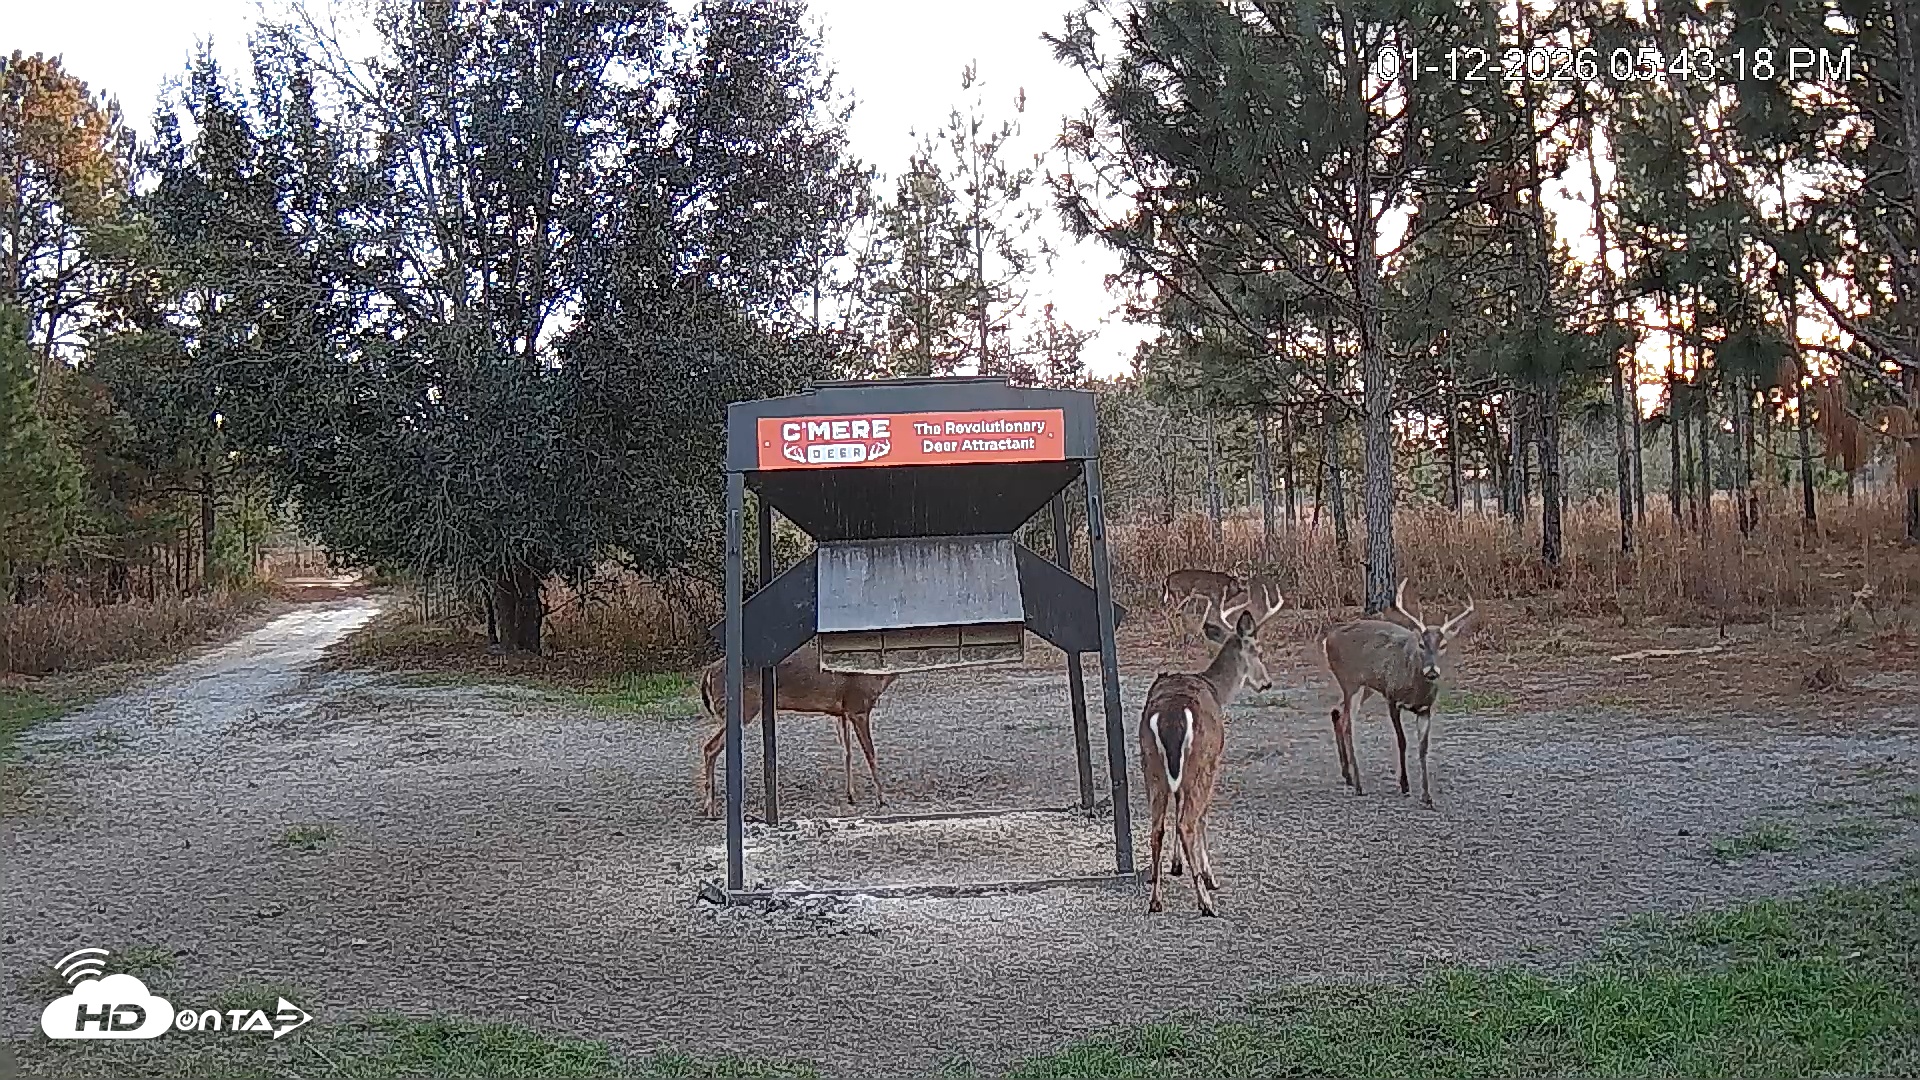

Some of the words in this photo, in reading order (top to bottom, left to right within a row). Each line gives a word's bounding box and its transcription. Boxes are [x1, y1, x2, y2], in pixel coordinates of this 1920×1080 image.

[914, 422, 940, 435] The
[945, 419, 1046, 434] Revolutionary
[961, 437, 1035, 451] Attractant
